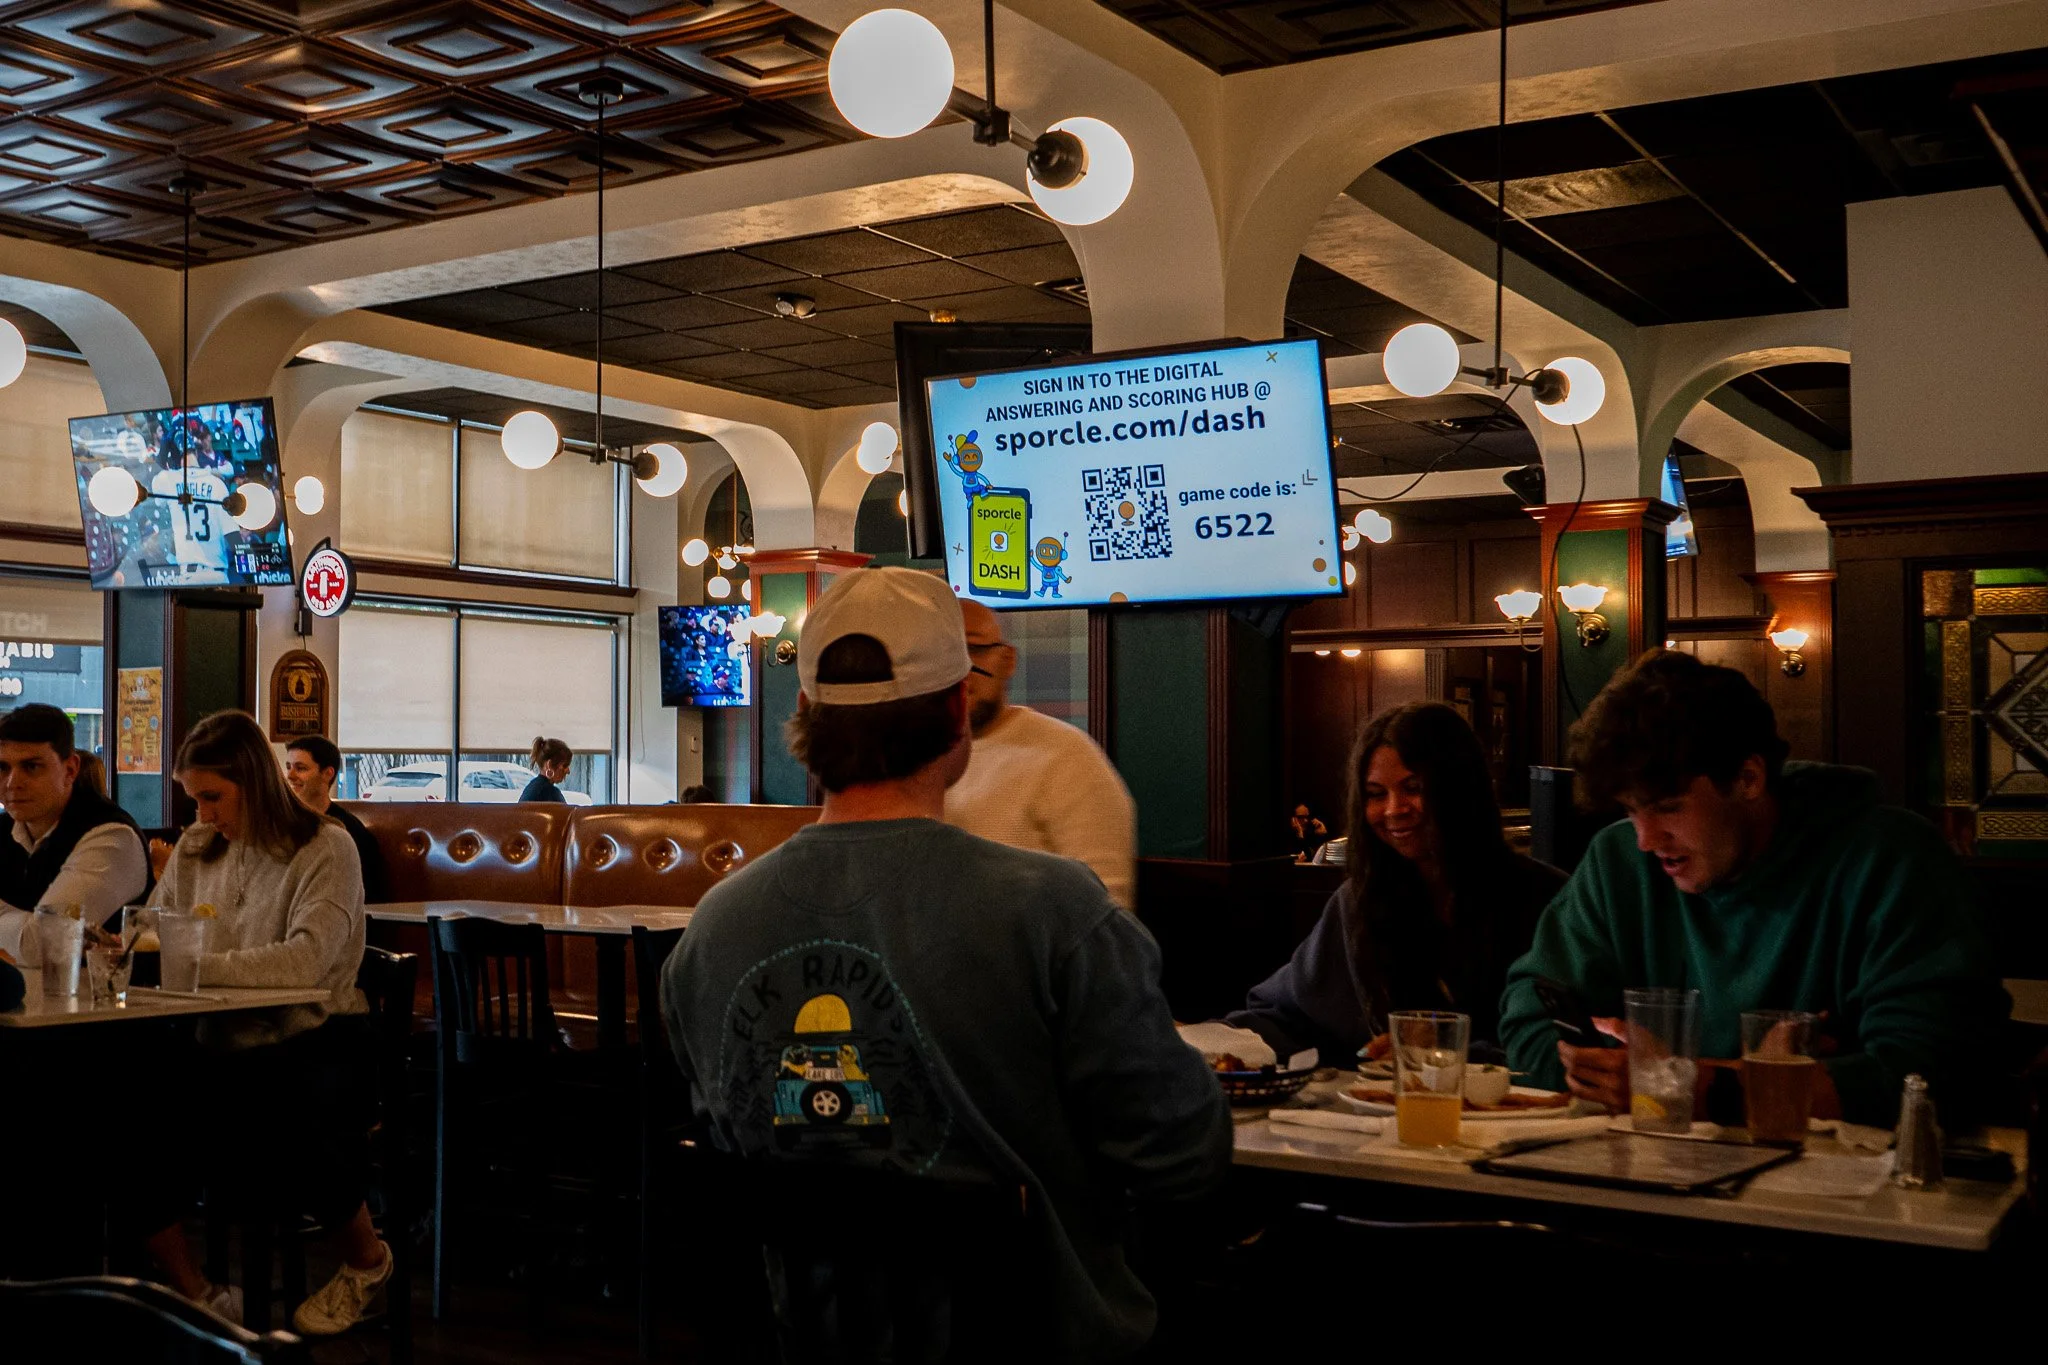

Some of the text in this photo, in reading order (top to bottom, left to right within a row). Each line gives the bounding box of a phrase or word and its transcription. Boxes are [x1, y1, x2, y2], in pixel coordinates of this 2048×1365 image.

[1023, 361, 1224, 396] SIGN IN TO THE DIGITAL
[985, 381, 1271, 423] ANSWERING AND SCORING HUB @
[995, 404, 1266, 457] sporcle.com/dash
[1178, 480, 1297, 507] game code is:
[181, 503, 211, 542] 13
[977, 508, 1022, 521] sporcle
[1194, 511, 1275, 540] 6522
[979, 562, 1020, 580] DASH
[733, 974, 782, 1041] ELK
